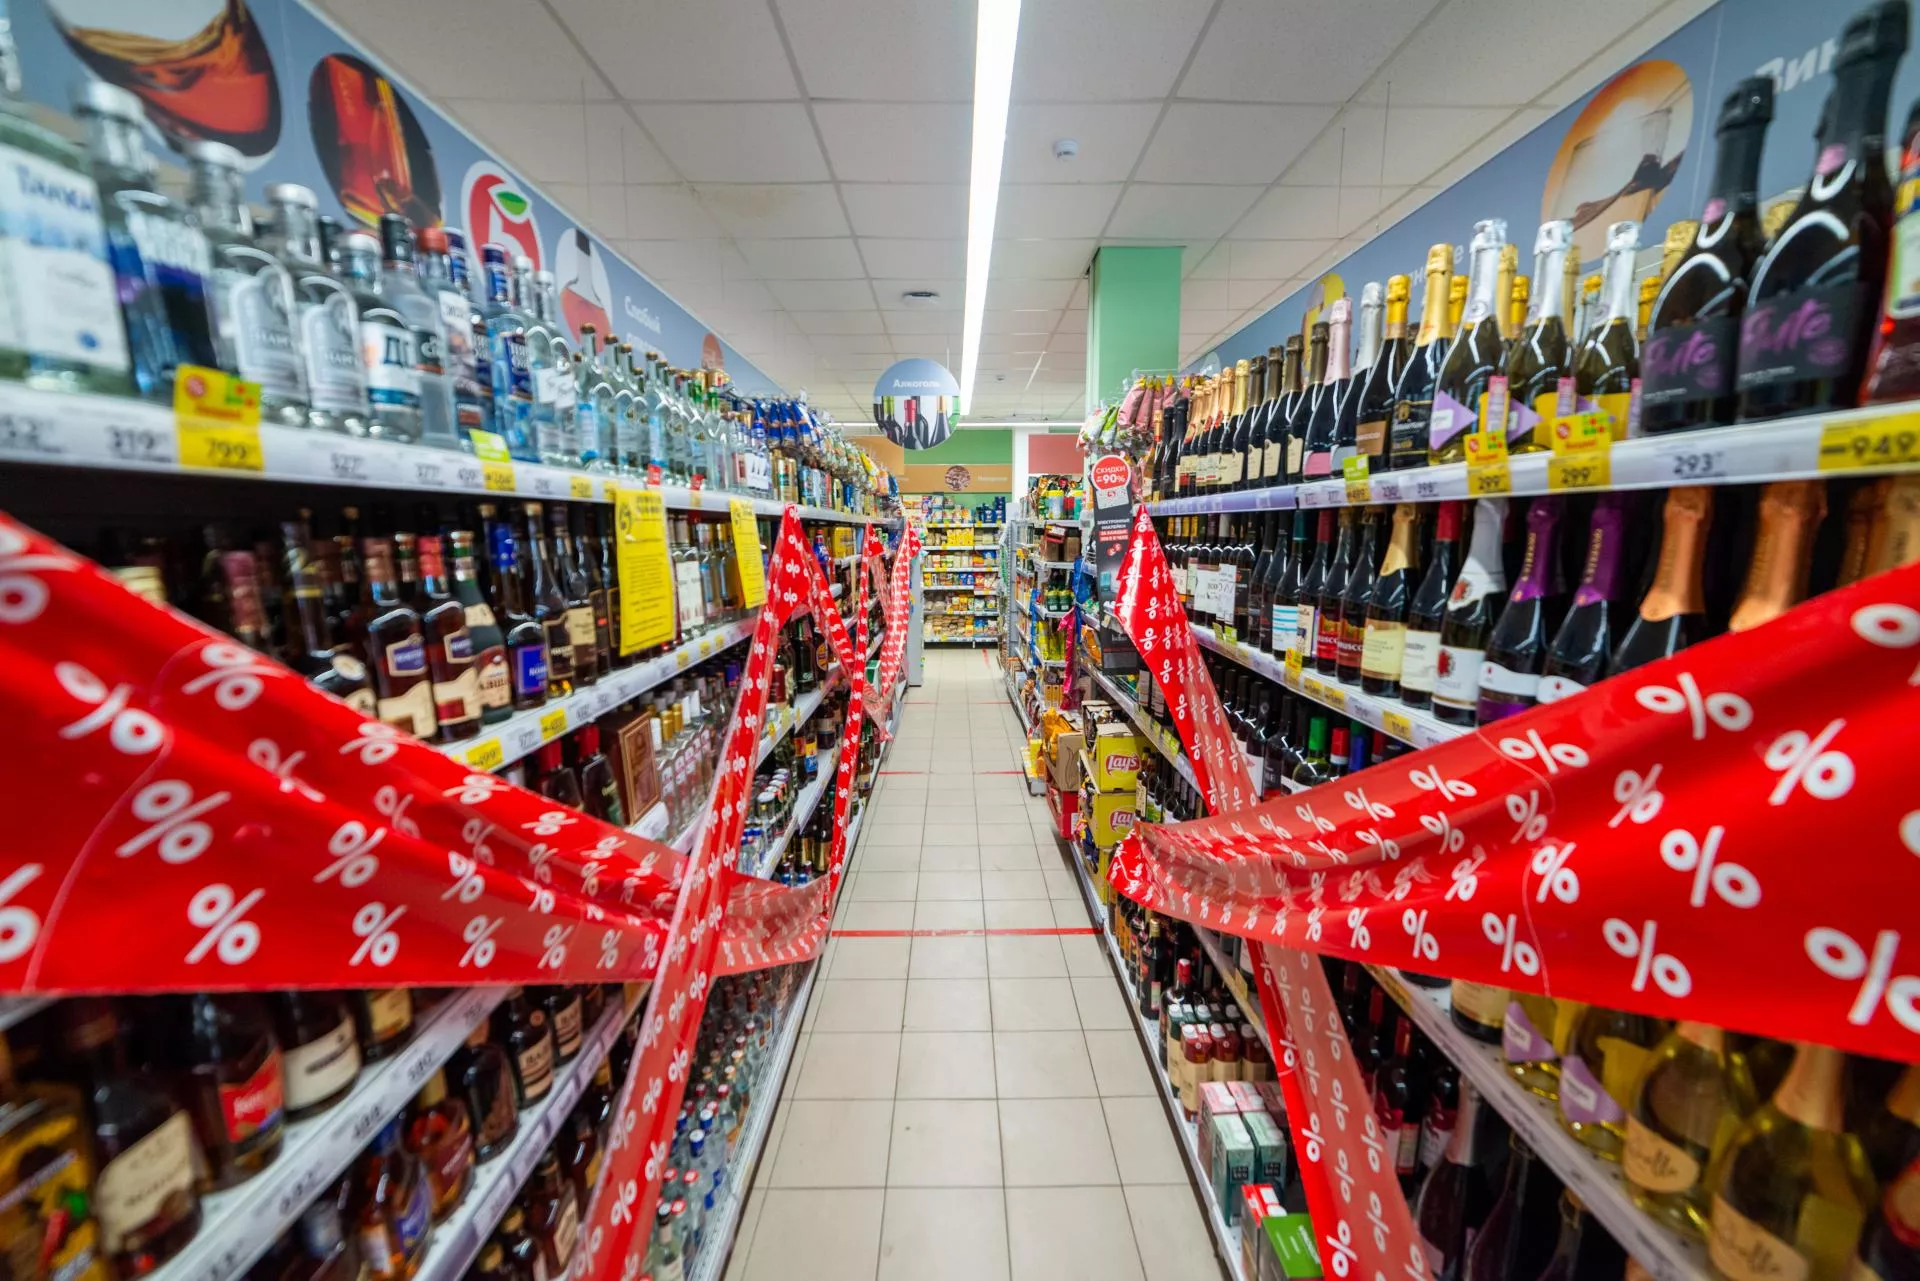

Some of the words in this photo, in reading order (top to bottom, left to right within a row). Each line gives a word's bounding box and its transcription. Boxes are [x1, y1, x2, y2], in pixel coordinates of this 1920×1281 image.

[893, 379, 940, 388] Алкоголь
[1096, 466, 1126, 474] СКИДКИ
[1108, 754, 1138, 772] Lay's
